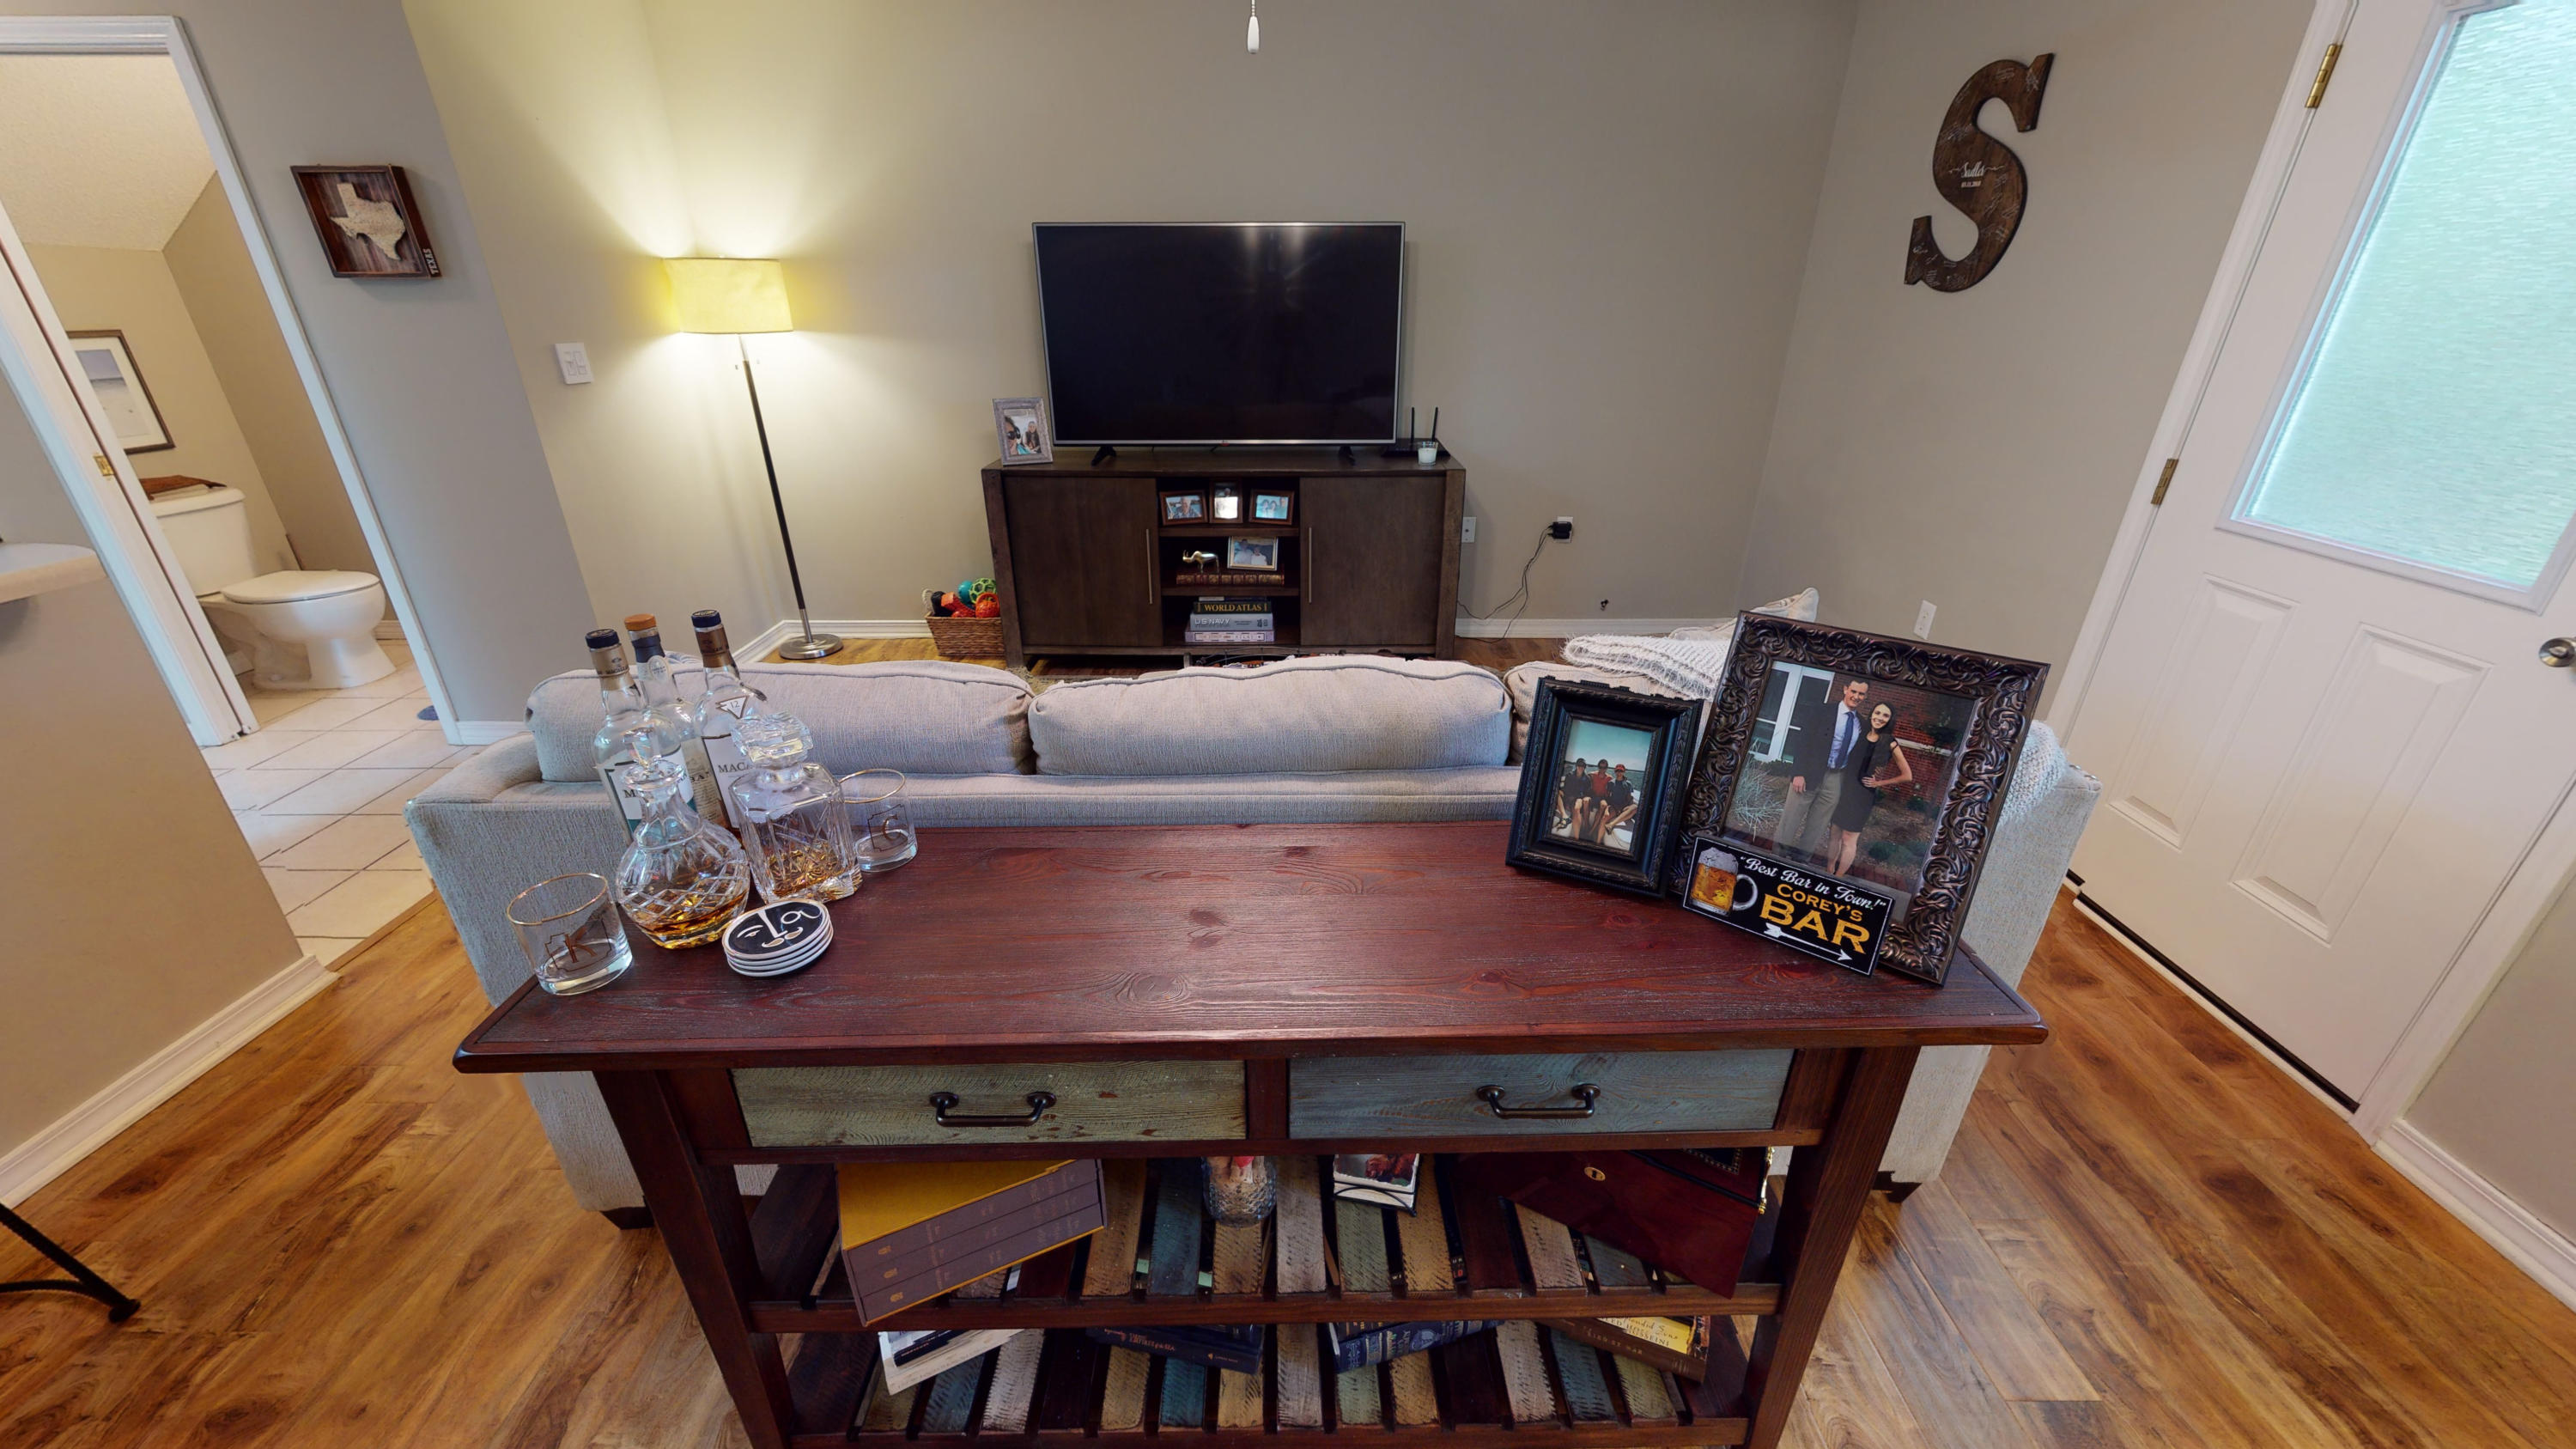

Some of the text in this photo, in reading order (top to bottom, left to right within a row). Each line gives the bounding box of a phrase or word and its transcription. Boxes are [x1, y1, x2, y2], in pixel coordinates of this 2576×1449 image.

[422, 248, 439, 275] TEXAS
[730, 700, 740, 709] 12
[1780, 869, 1813, 888] Bar
[1814, 882, 1831, 895] in
[1777, 883, 1863, 922] COREY'S
[1759, 893, 1870, 954] BAR
